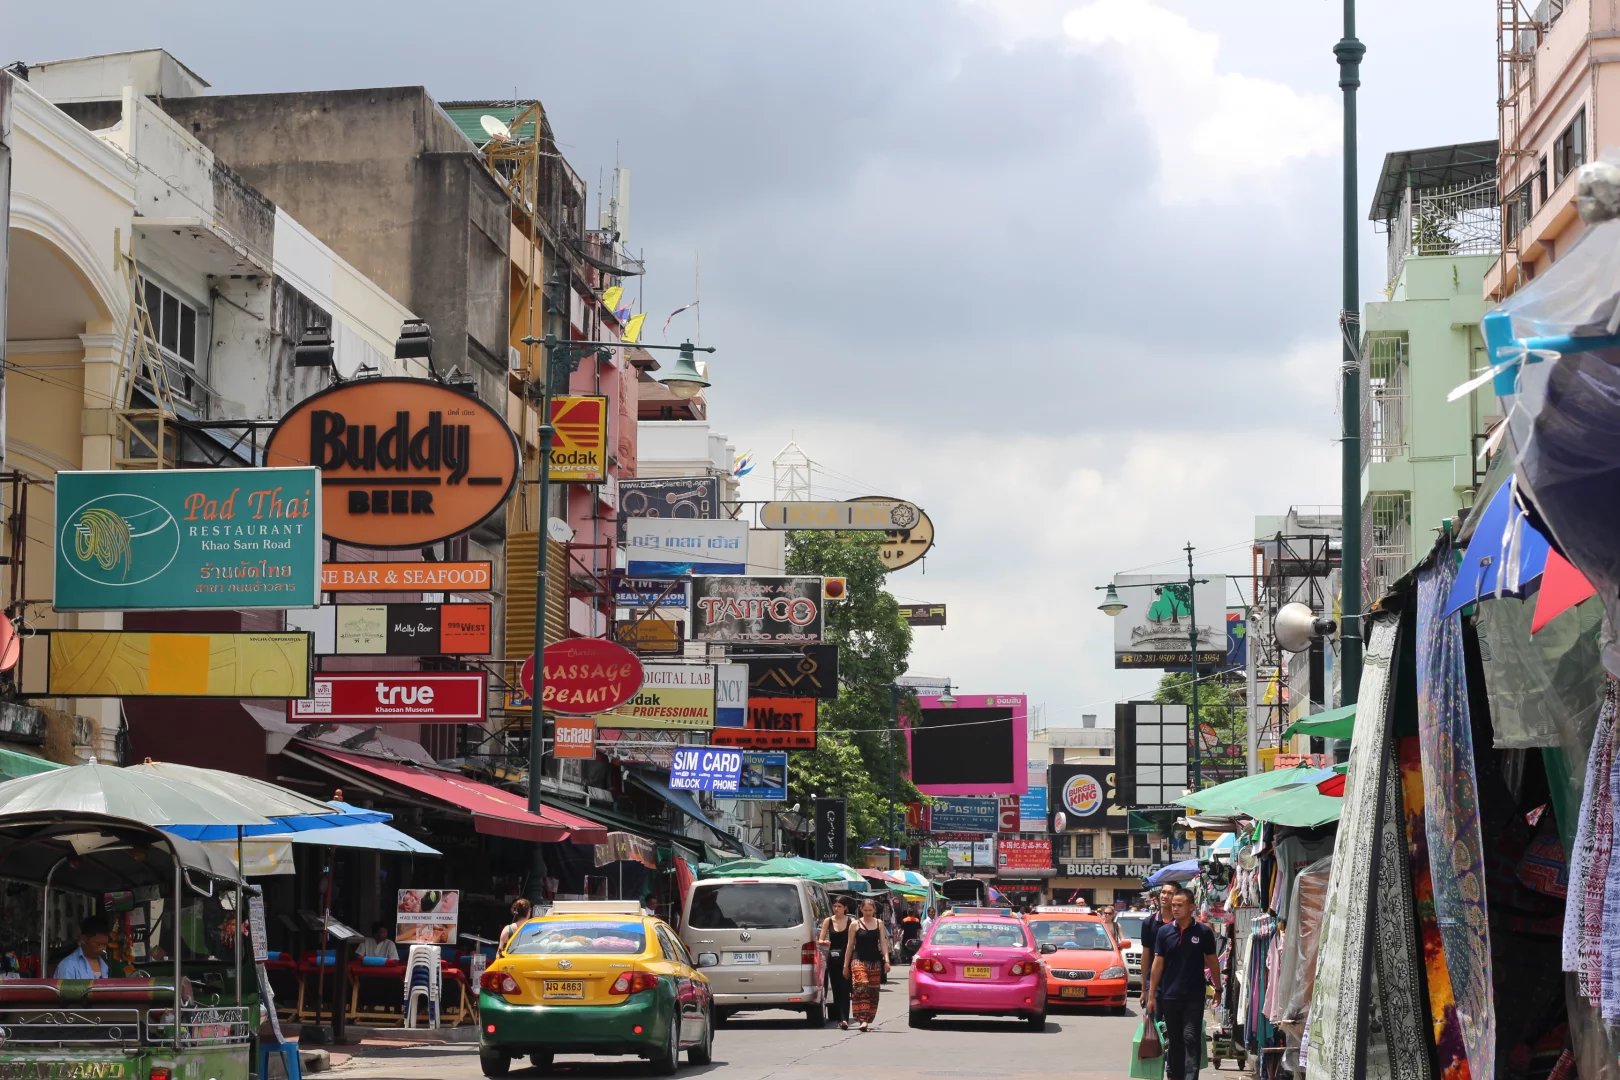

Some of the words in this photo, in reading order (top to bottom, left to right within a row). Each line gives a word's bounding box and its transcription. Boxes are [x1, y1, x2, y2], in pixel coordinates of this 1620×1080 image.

[310, 409, 471, 486] Buddy
[549, 450, 598, 465] Kodak
[549, 464, 599, 473] express
[184, 486, 240, 520] Pad
[247, 486, 311, 520] Thai
[348, 489, 434, 515] BEER
[189, 524, 304, 537] RESTAURANT
[201, 540, 230, 551] Khao
[233, 540, 260, 550] Sarn
[263, 538, 292, 550] Road
[200, 559, 292, 579] ร้านผัดไทย
[343, 570, 380, 585] BAR
[384, 570, 402, 584] &
[403, 569, 488, 584] SEAFOOD
[696, 596, 818, 627] TATTOO
[417, 622, 434, 633] Bar
[775, 632, 818, 641] GROUP
[1133, 653, 1177, 664] 02-281-9509
[1178, 653, 1220, 664] 02-21-5954
[530, 662, 633, 681] MASSAGE
[643, 671, 687, 685] DIGITAL
[690, 671, 711, 685] LAB
[375, 682, 435, 705] true
[542, 682, 622, 704] BEAUTY
[627, 692, 661, 706] odak
[632, 706, 709, 718] PROFESSIONAL
[673, 750, 699, 771] SIM
[702, 752, 740, 772] CARD
[671, 777, 701, 789] UNLOCK
[712, 779, 738, 790] PHONE
[1068, 783, 1097, 798] BURGER
[1069, 789, 1097, 807] KING
[1066, 864, 1118, 877] BURGER
[1124, 863, 1161, 877] KING
[560, 982, 582, 992] 4863
